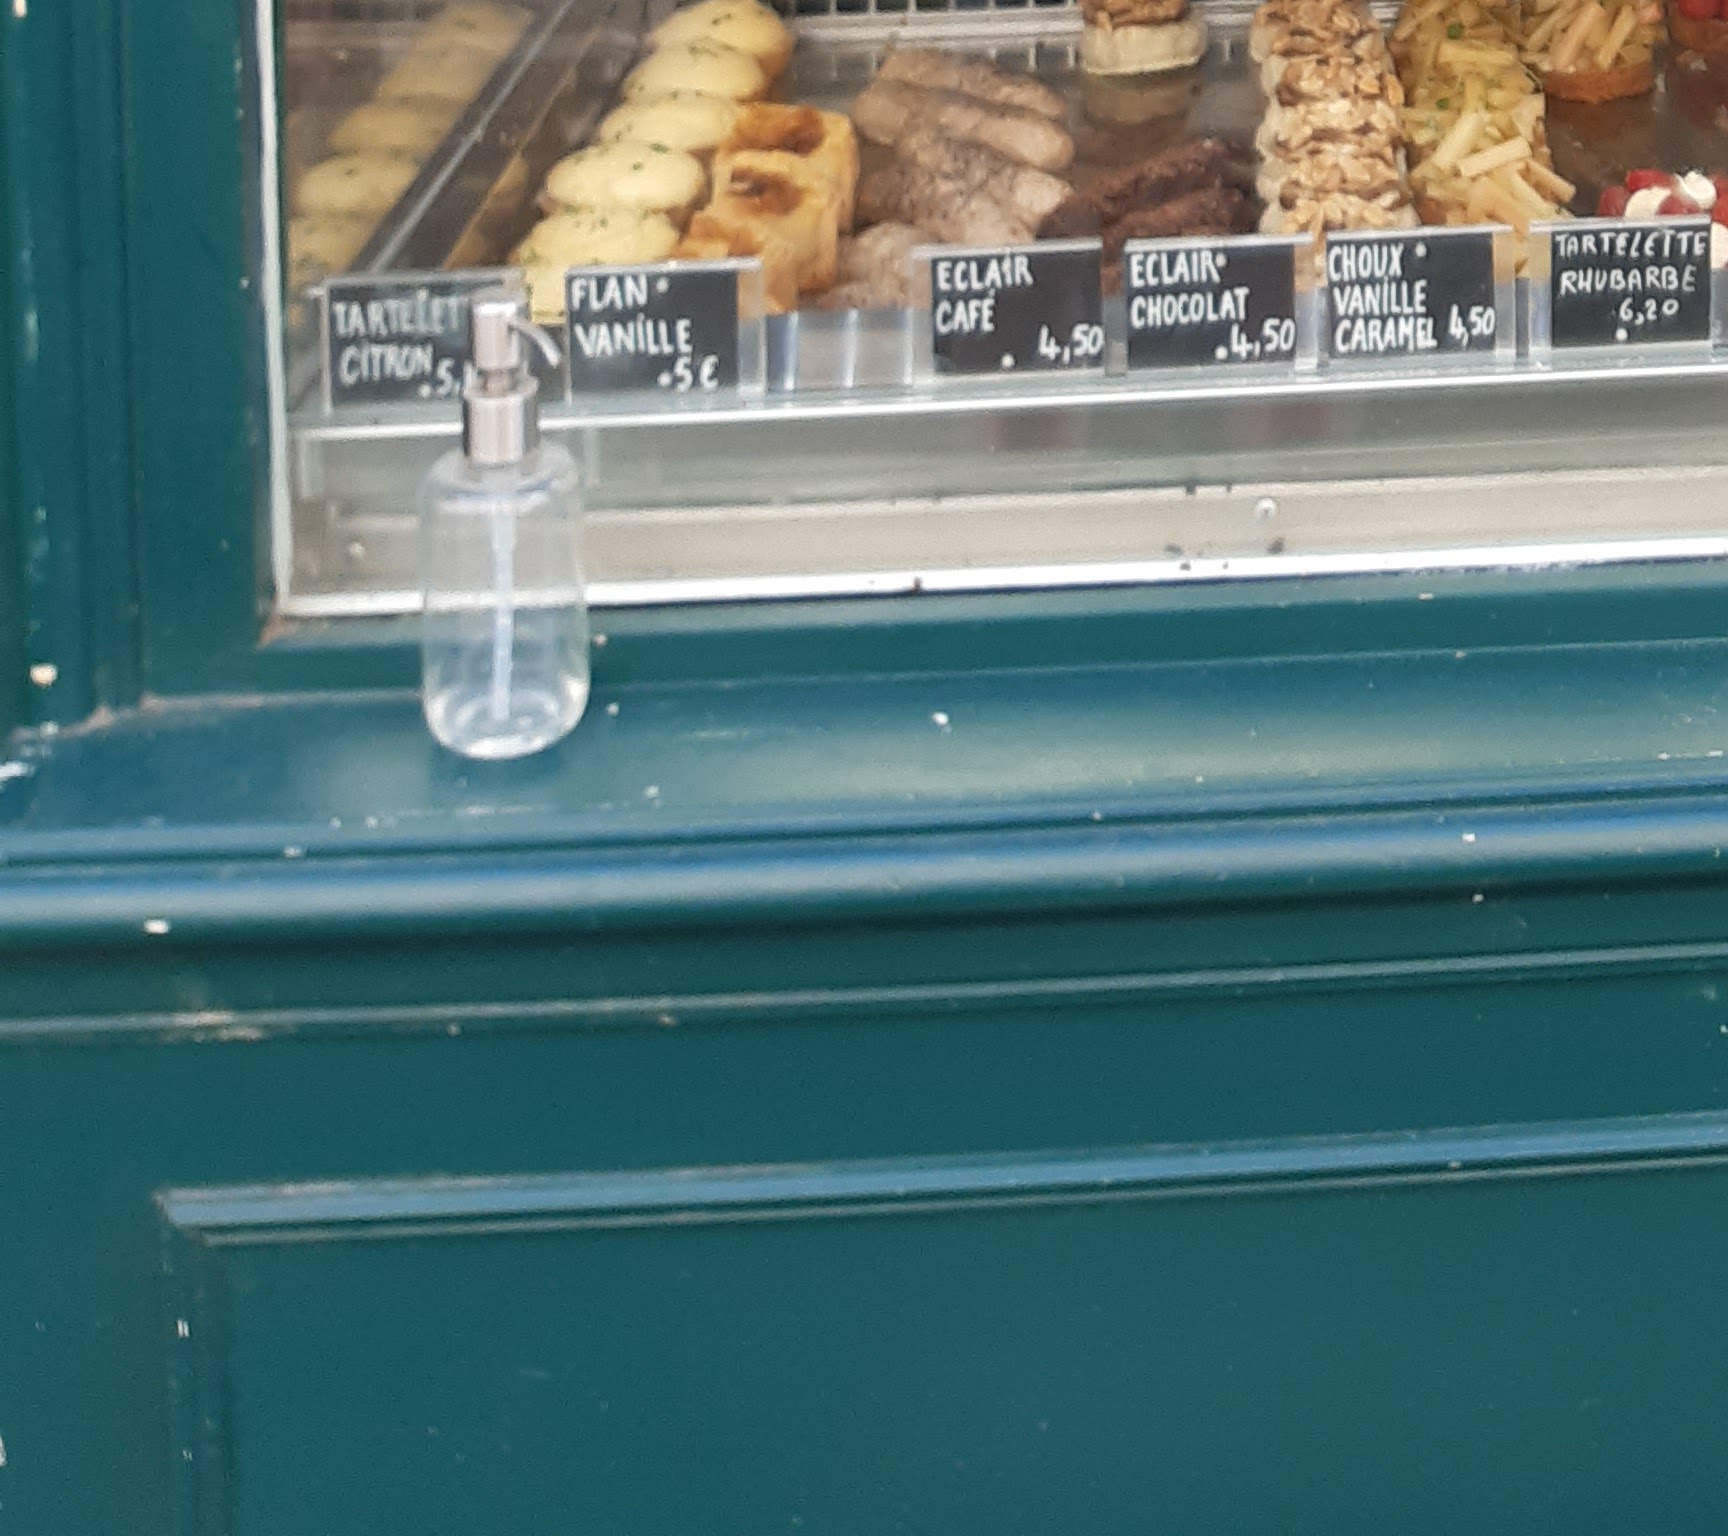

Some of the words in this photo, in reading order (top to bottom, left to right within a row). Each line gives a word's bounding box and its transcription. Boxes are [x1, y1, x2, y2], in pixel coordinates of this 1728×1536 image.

[1327, 243, 1405, 282] CHOUX
[1554, 229, 1709, 259] TARTELETTE
[935, 255, 1035, 291] ECLAIR
[1128, 251, 1222, 287] ECLAIR
[1558, 264, 1698, 296] RHUBARBE
[570, 273, 650, 312] FLAN
[934, 288, 997, 335] CAFÉ
[1128, 286, 1250, 329] CHOCOLAT
[1332, 277, 1428, 318] VANILLE
[1618, 297, 1681, 326] 6,20
[575, 315, 694, 358] VANILLE
[1037, 323, 1103, 365] 4,50
[1230, 317, 1296, 358] 4,50
[1335, 316, 1438, 354] CARAMEL
[1448, 304, 1496, 349] 4,50
[338, 338, 434, 387] CITRON
